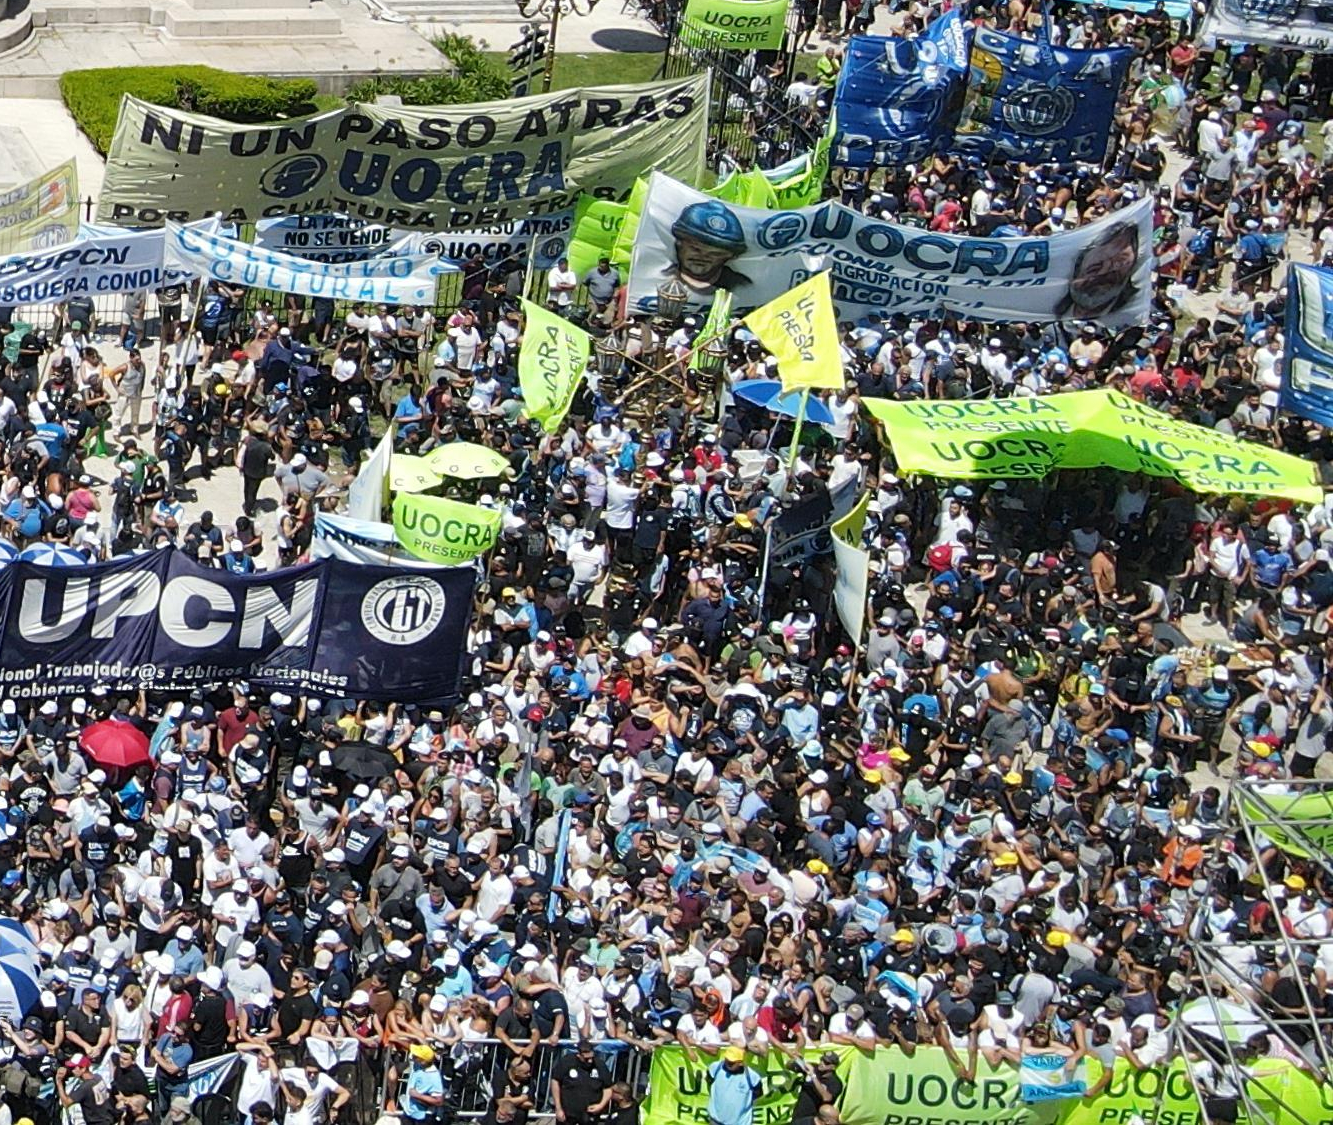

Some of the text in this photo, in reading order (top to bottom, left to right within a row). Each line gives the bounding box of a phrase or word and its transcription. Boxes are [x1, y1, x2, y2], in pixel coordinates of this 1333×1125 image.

[704, 9, 773, 29] UOCRA
[701, 26, 770, 44] PRESENTE
[141, 89, 696, 157] NI UN PASO ATRAS
[338, 140, 567, 207] UOCRA
[113, 203, 186, 223] POR
[201, 208, 250, 225] LA
[262, 195, 433, 229] CULTURA
[450, 206, 514, 228] DEL
[529, 181, 635, 217] TRABA
[284, 231, 309, 246] NO
[338, 230, 392, 246] VENDE
[519, 215, 571, 236] ATRAS
[448, 242, 527, 262] UOCRA
[809, 206, 1051, 276] UOCRA
[210, 257, 401, 304] CULTURAL
[833, 262, 951, 297] AGRUPACION
[904, 396, 1061, 421] UOCRA
[924, 420, 1072, 434] PRESENTE
[401, 504, 492, 547] UOCRA
[18, 568, 319, 649] UPCN
[46, 662, 166, 681] Trabajador@s
[171, 663, 244, 680] Públicos
[249, 662, 349, 687] Nacionales
[8, 682, 87, 699] Gobierno
